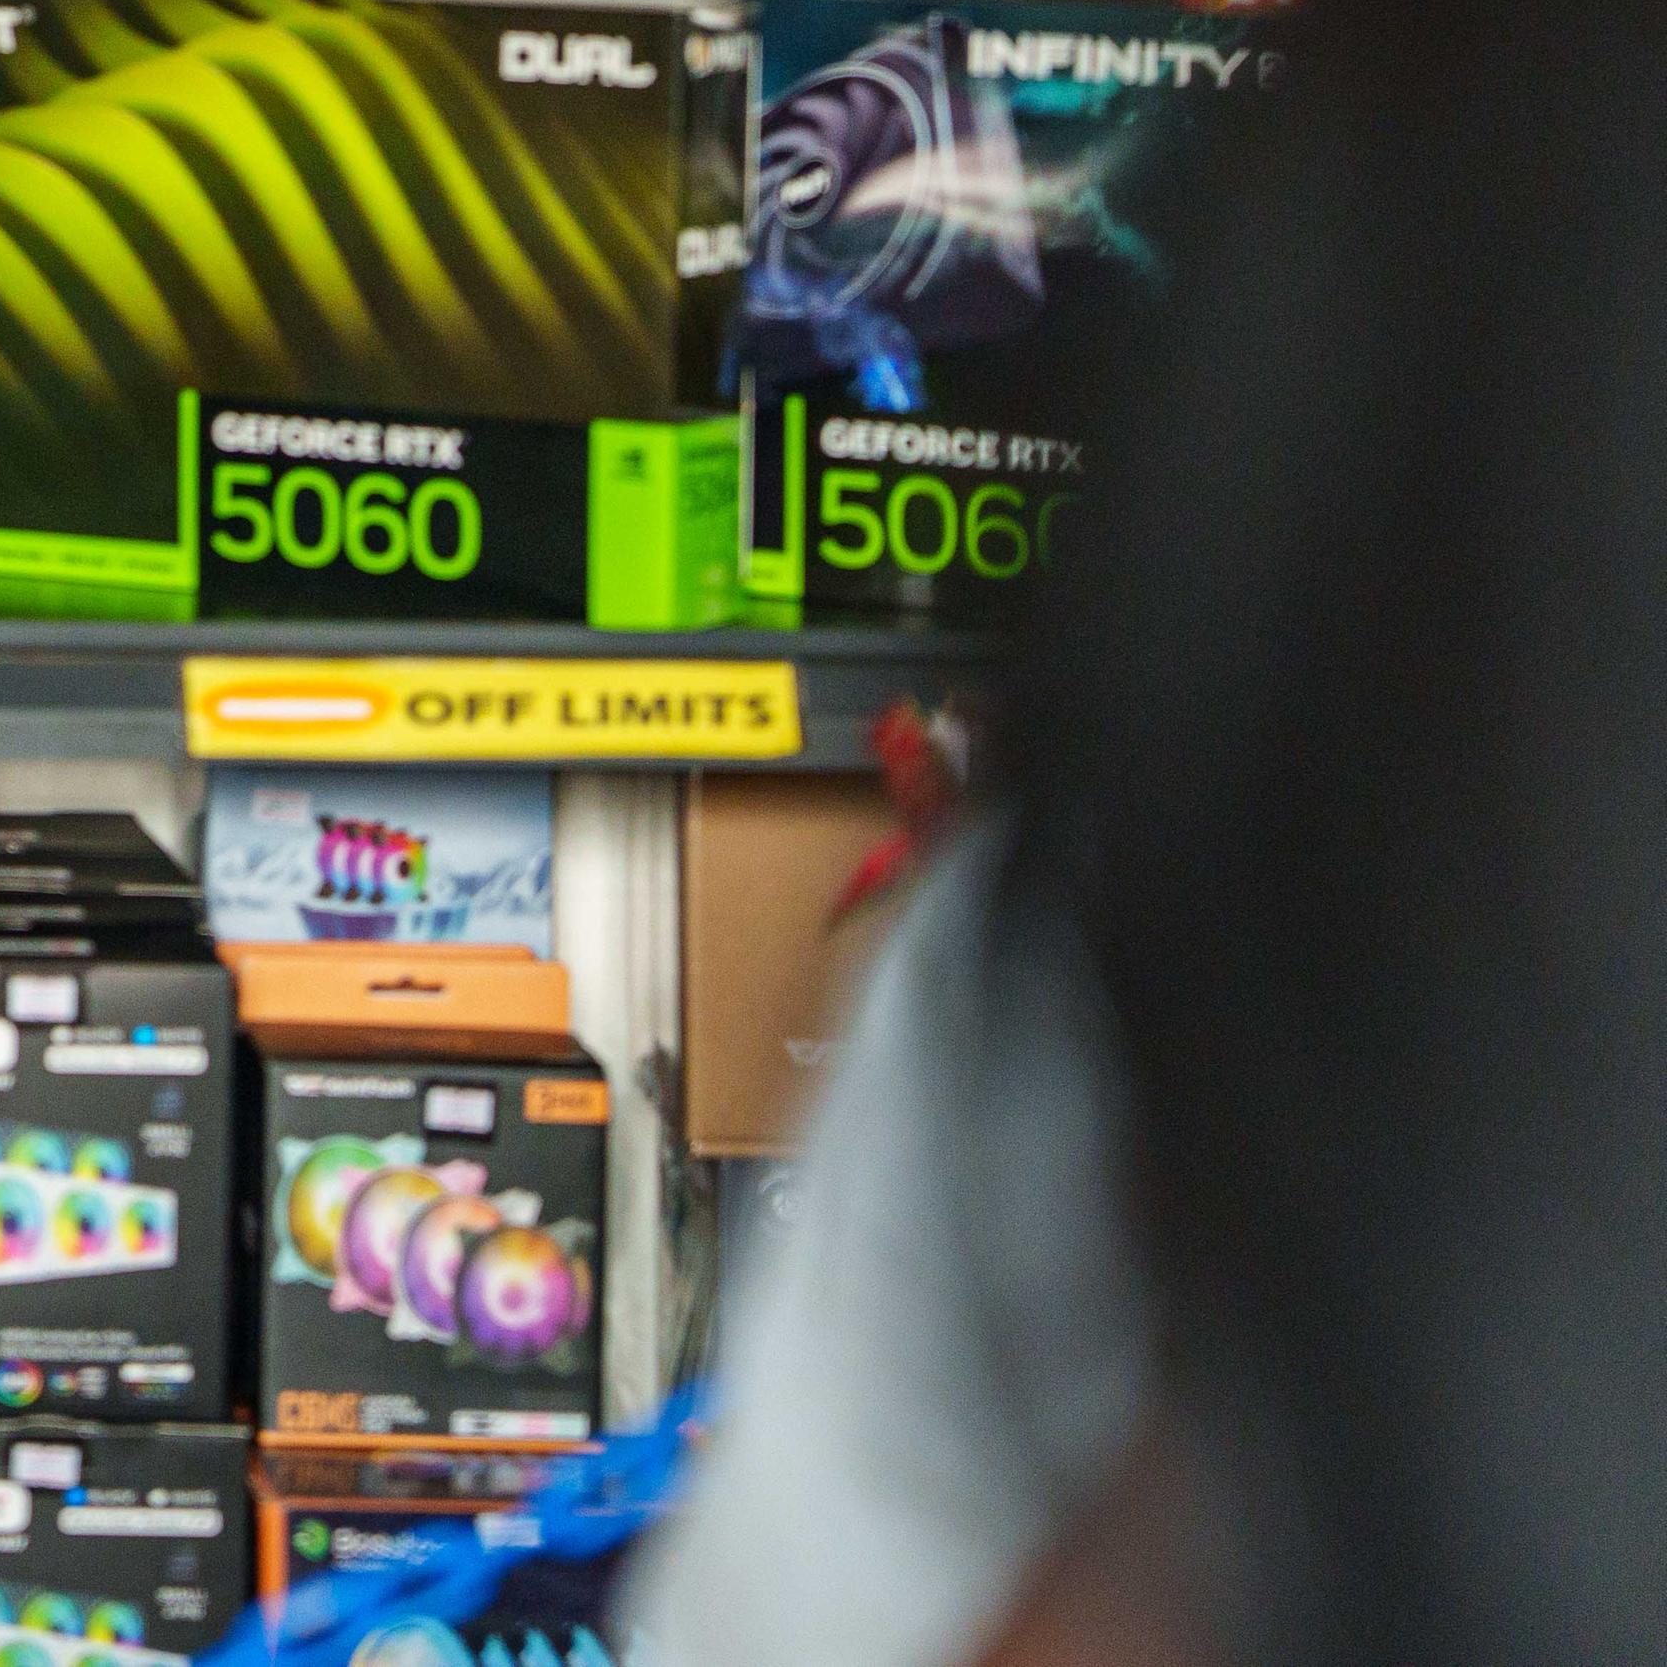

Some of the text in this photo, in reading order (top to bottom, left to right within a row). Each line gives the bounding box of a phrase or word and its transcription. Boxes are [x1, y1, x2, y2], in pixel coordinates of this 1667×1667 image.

[968, 29, 1250, 89] INFINITY
[211, 413, 465, 471] GEFORCE RTX
[820, 418, 1085, 474] GEFORCE RTX
[210, 465, 483, 581] 5060
[406, 693, 771, 725] OFF LIMITS
